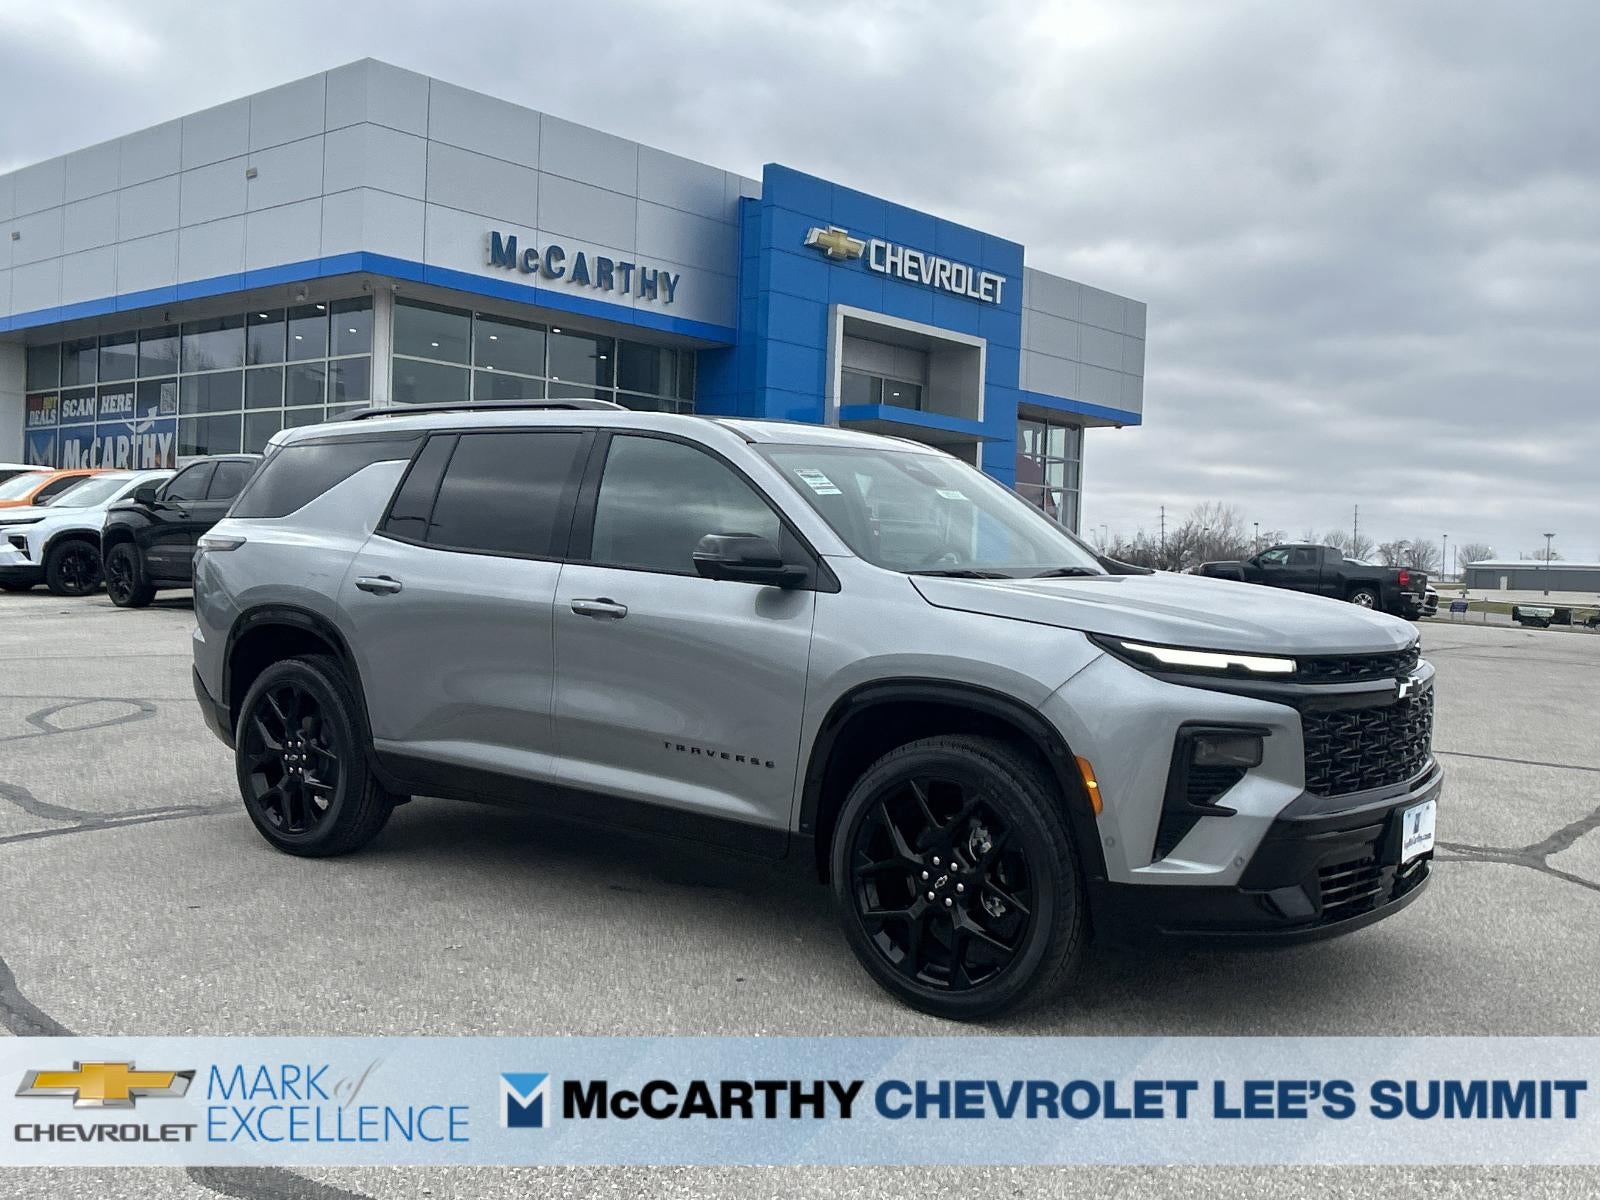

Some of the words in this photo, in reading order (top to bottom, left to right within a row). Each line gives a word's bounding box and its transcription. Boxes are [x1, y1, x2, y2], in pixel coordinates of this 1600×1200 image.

[485, 230, 681, 304] McCARTHY
[868, 238, 1007, 305] CHEVROLET
[29, 409, 57, 426] DEALS
[63, 397, 95, 418] SCAN
[101, 393, 133, 414] HERE
[64, 432, 173, 469] McCARTHY
[664, 741, 775, 769] TRAVERSE
